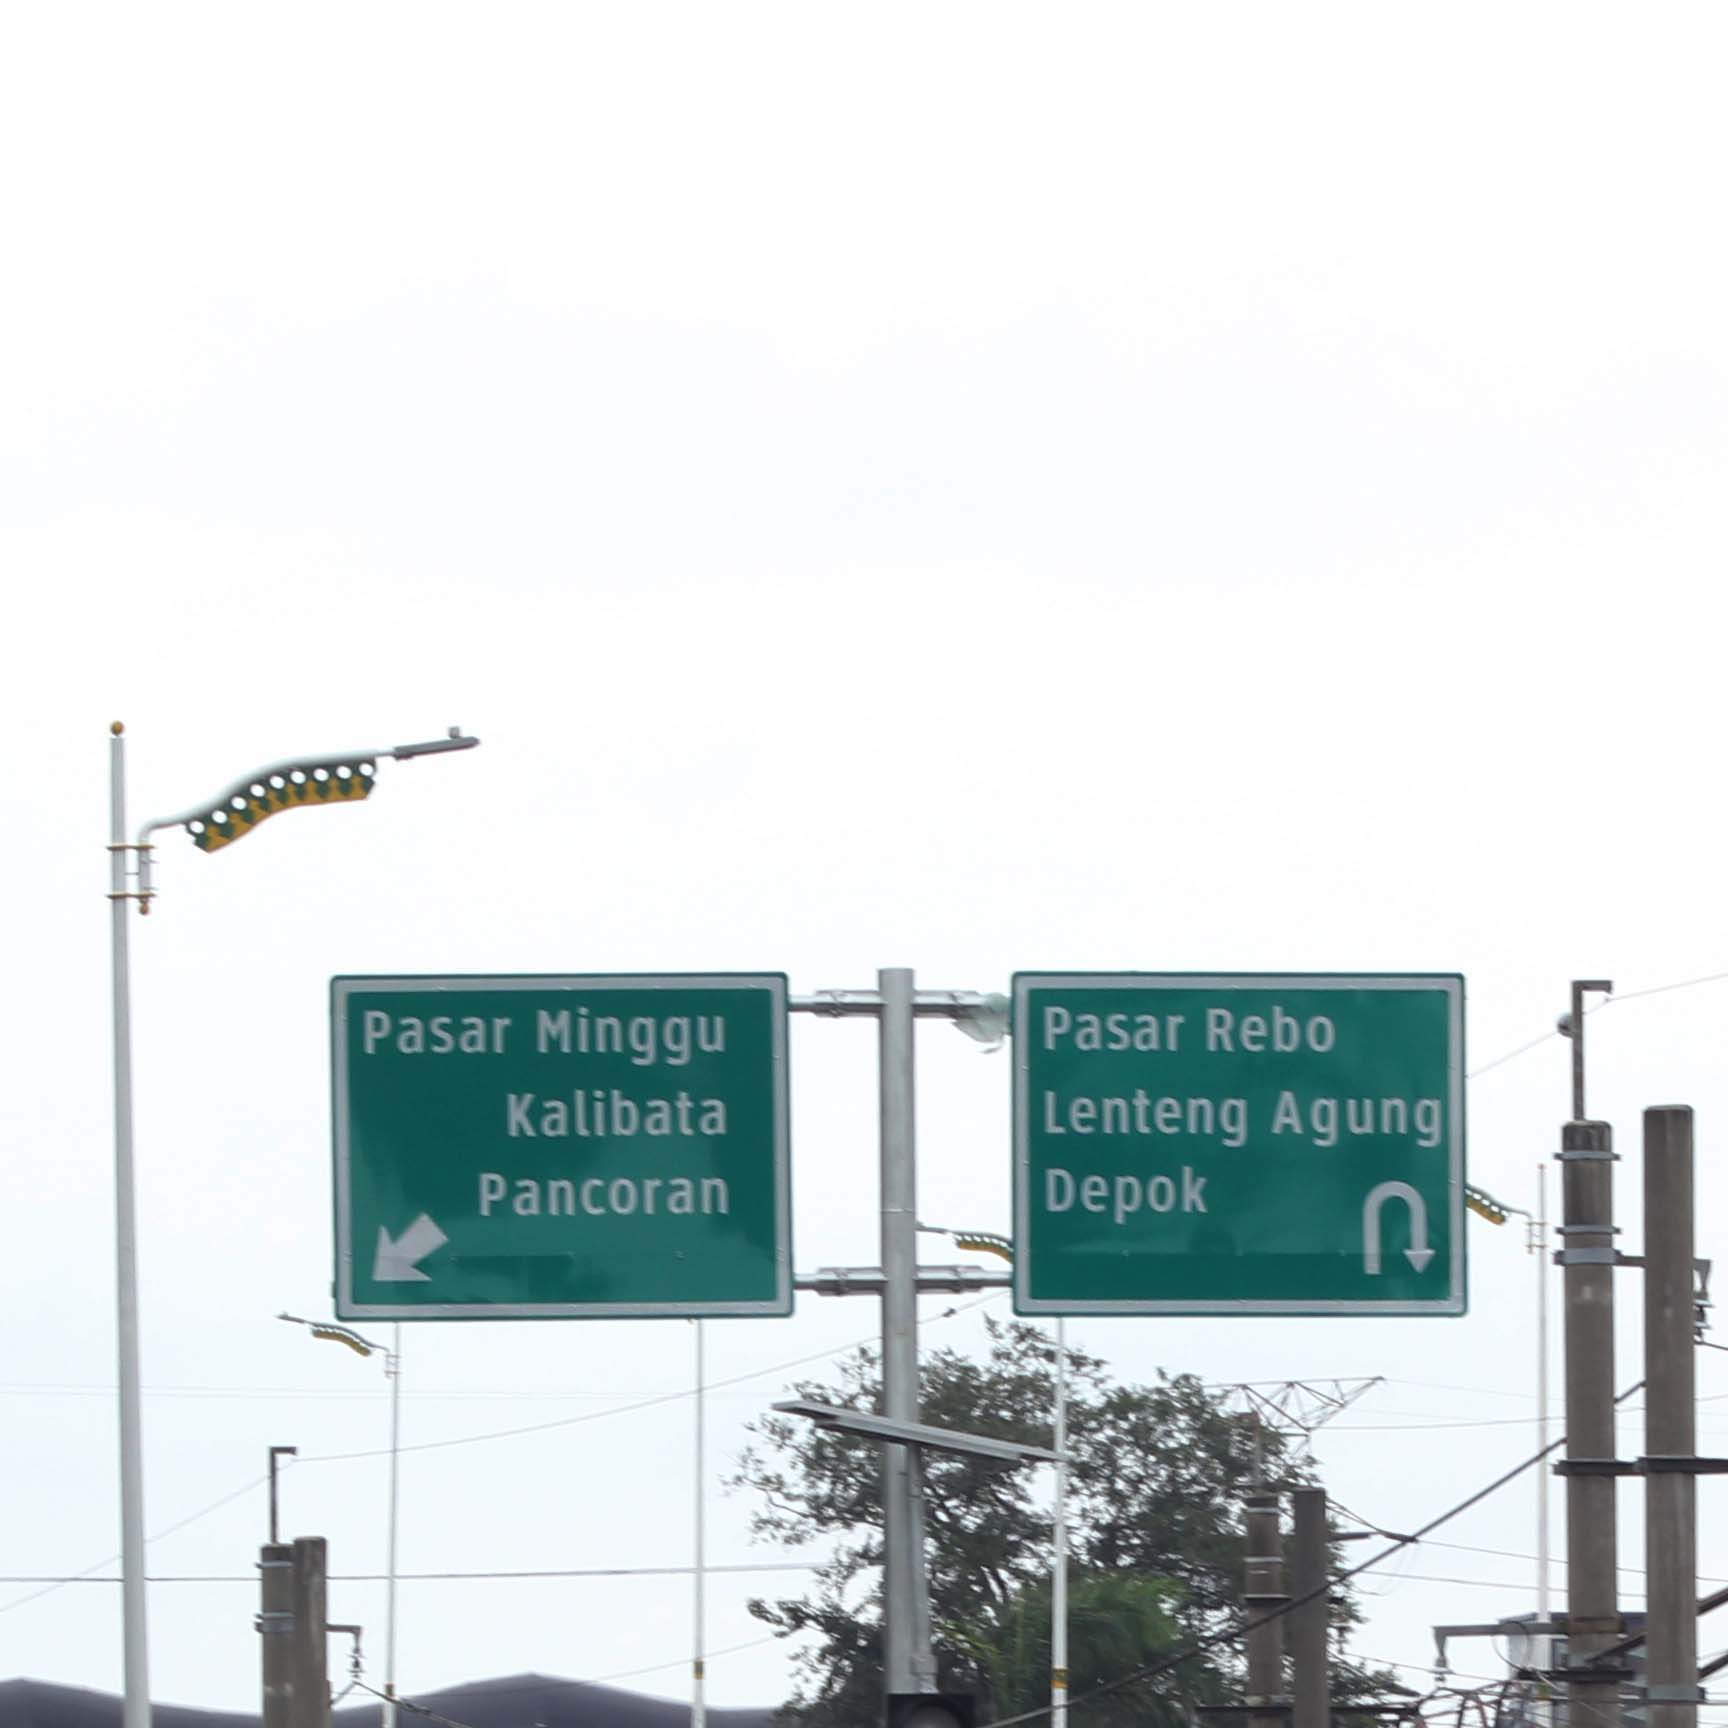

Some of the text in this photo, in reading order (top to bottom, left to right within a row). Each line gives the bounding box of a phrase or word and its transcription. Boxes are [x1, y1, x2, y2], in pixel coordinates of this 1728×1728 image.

[364, 1007, 726, 1067] Pasar Minggu
[1044, 1006, 1336, 1053] Pasar Rebo
[508, 1089, 727, 1137] Kalibata
[1045, 1089, 1442, 1148] Lenteng Agung
[480, 1172, 729, 1217] Pancoran
[1046, 1165, 1207, 1224] Depok
